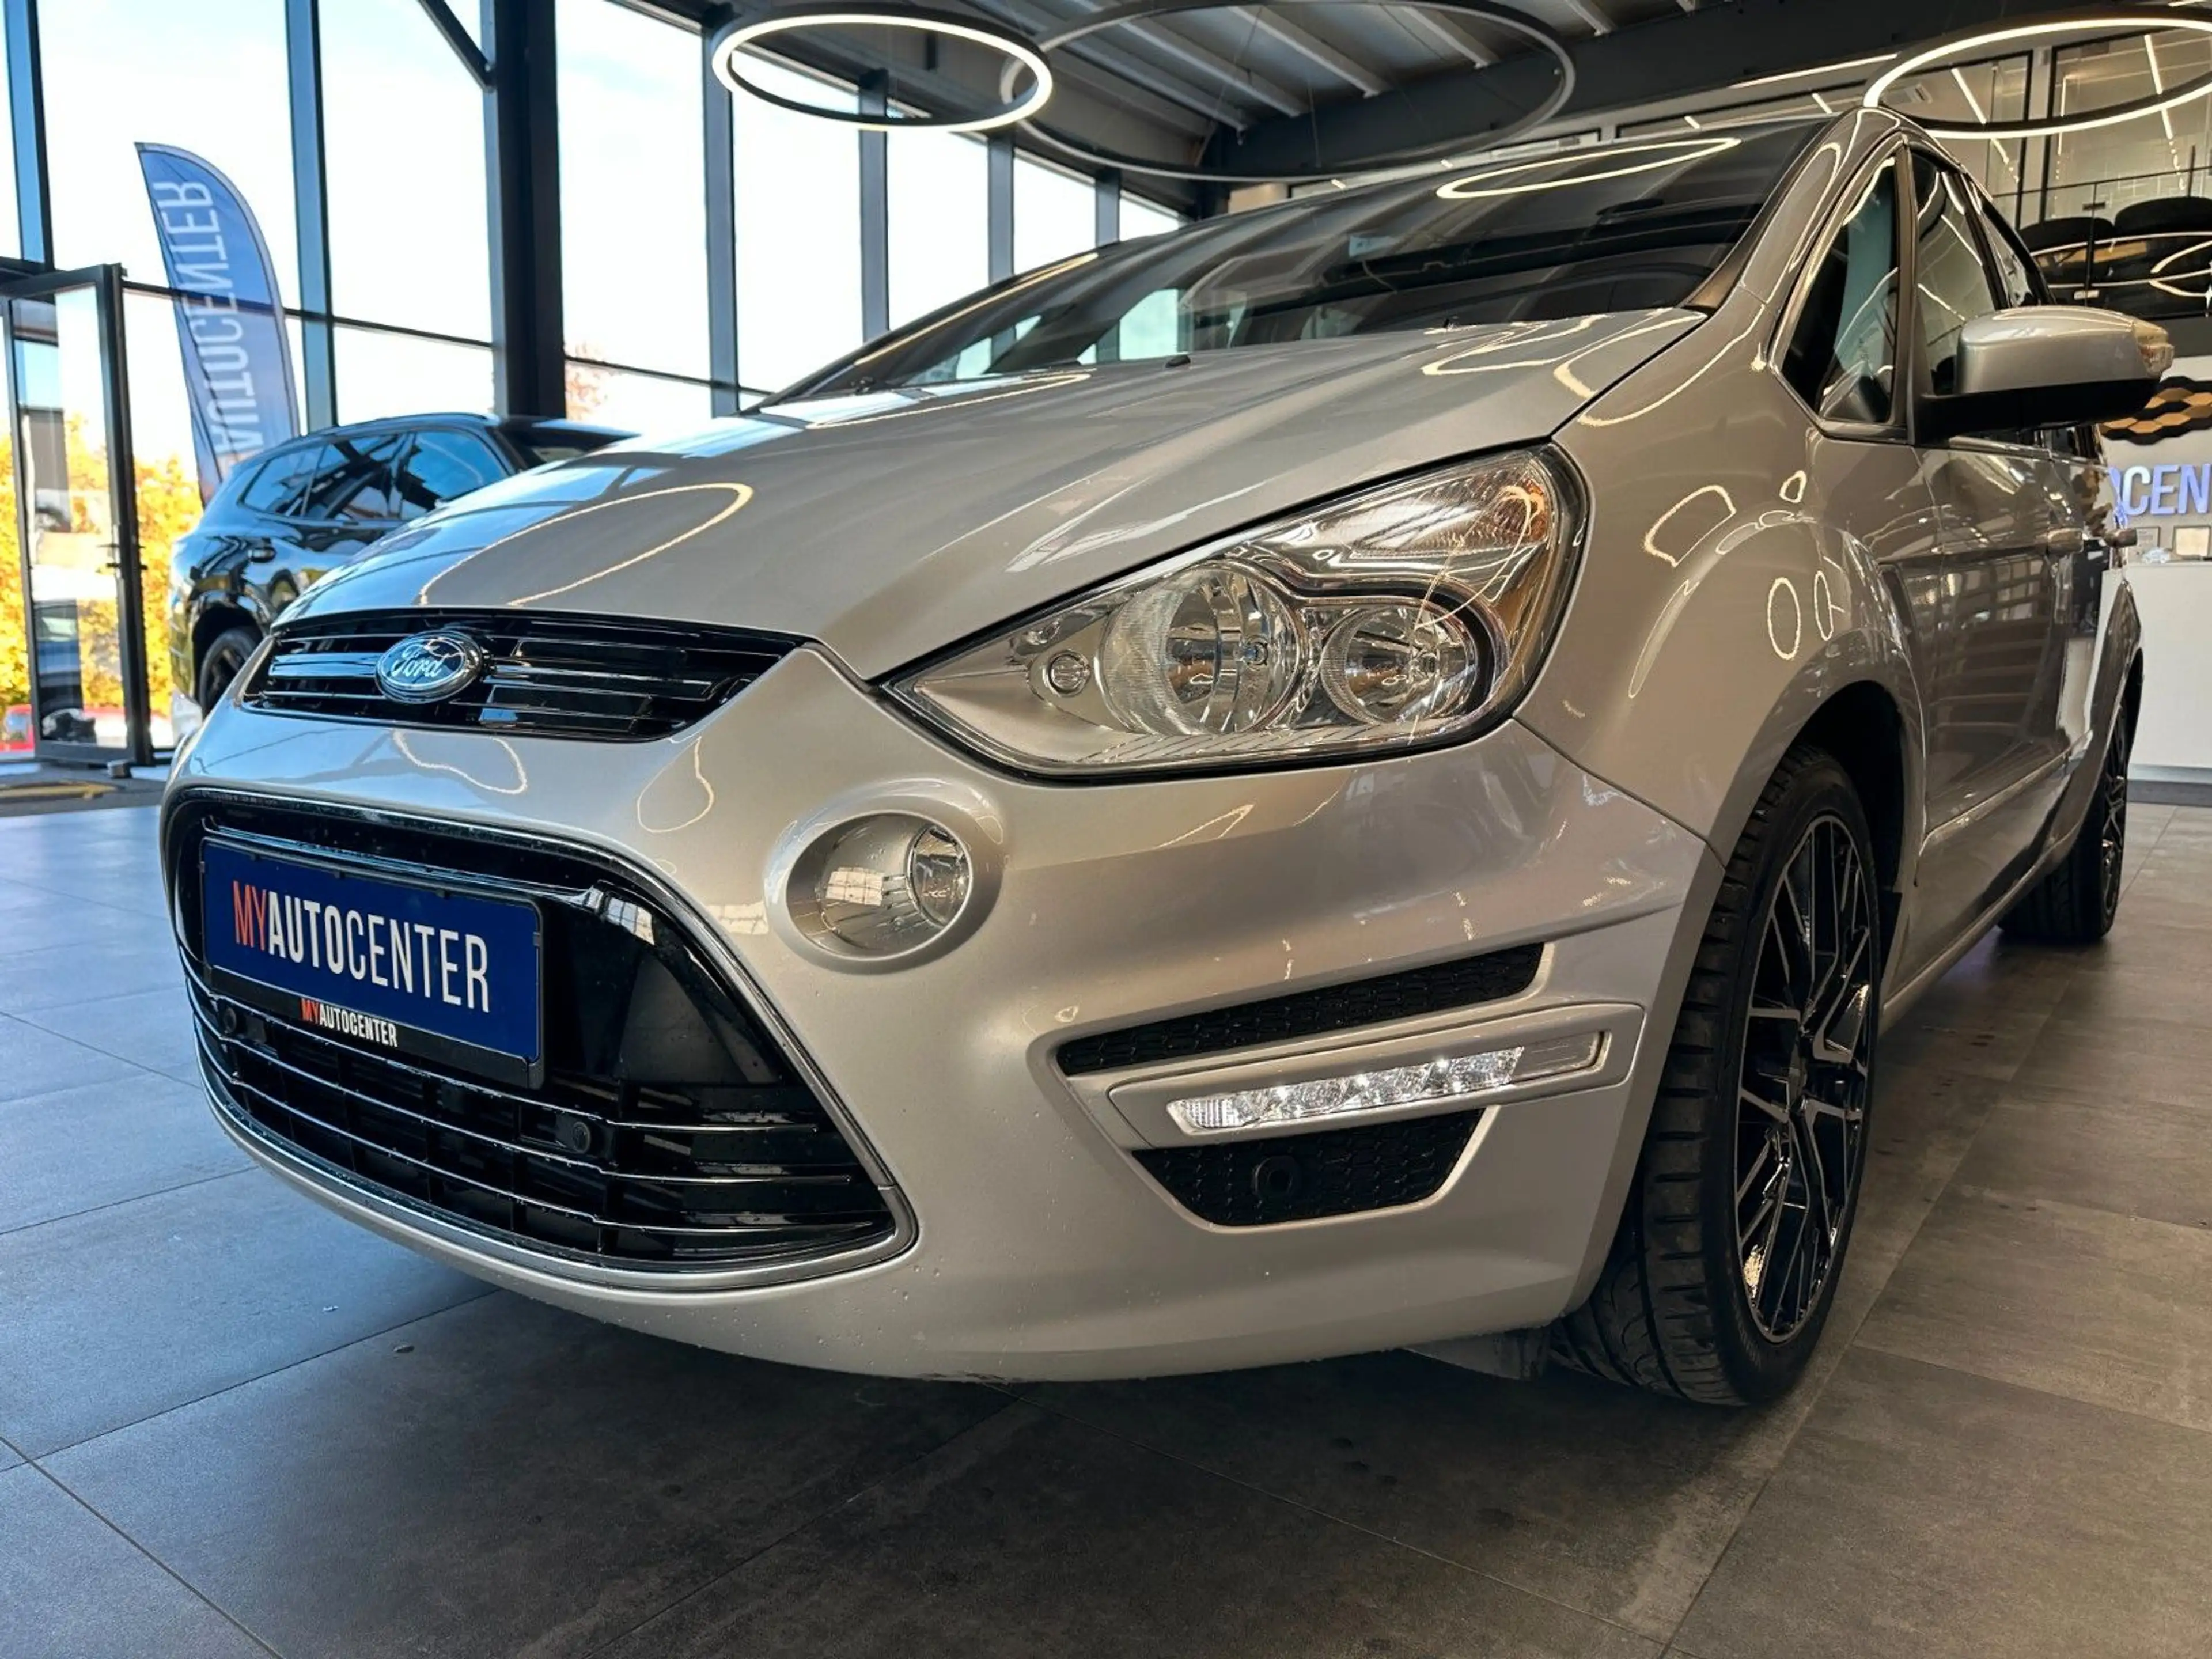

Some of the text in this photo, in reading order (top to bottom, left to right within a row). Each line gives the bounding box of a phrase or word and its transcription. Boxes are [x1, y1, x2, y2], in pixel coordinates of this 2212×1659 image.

[391, 643, 452, 678] Ford
[233, 880, 490, 1013] MYAUTOCENTER
[301, 998, 398, 1048] MYAUTOCENTER
